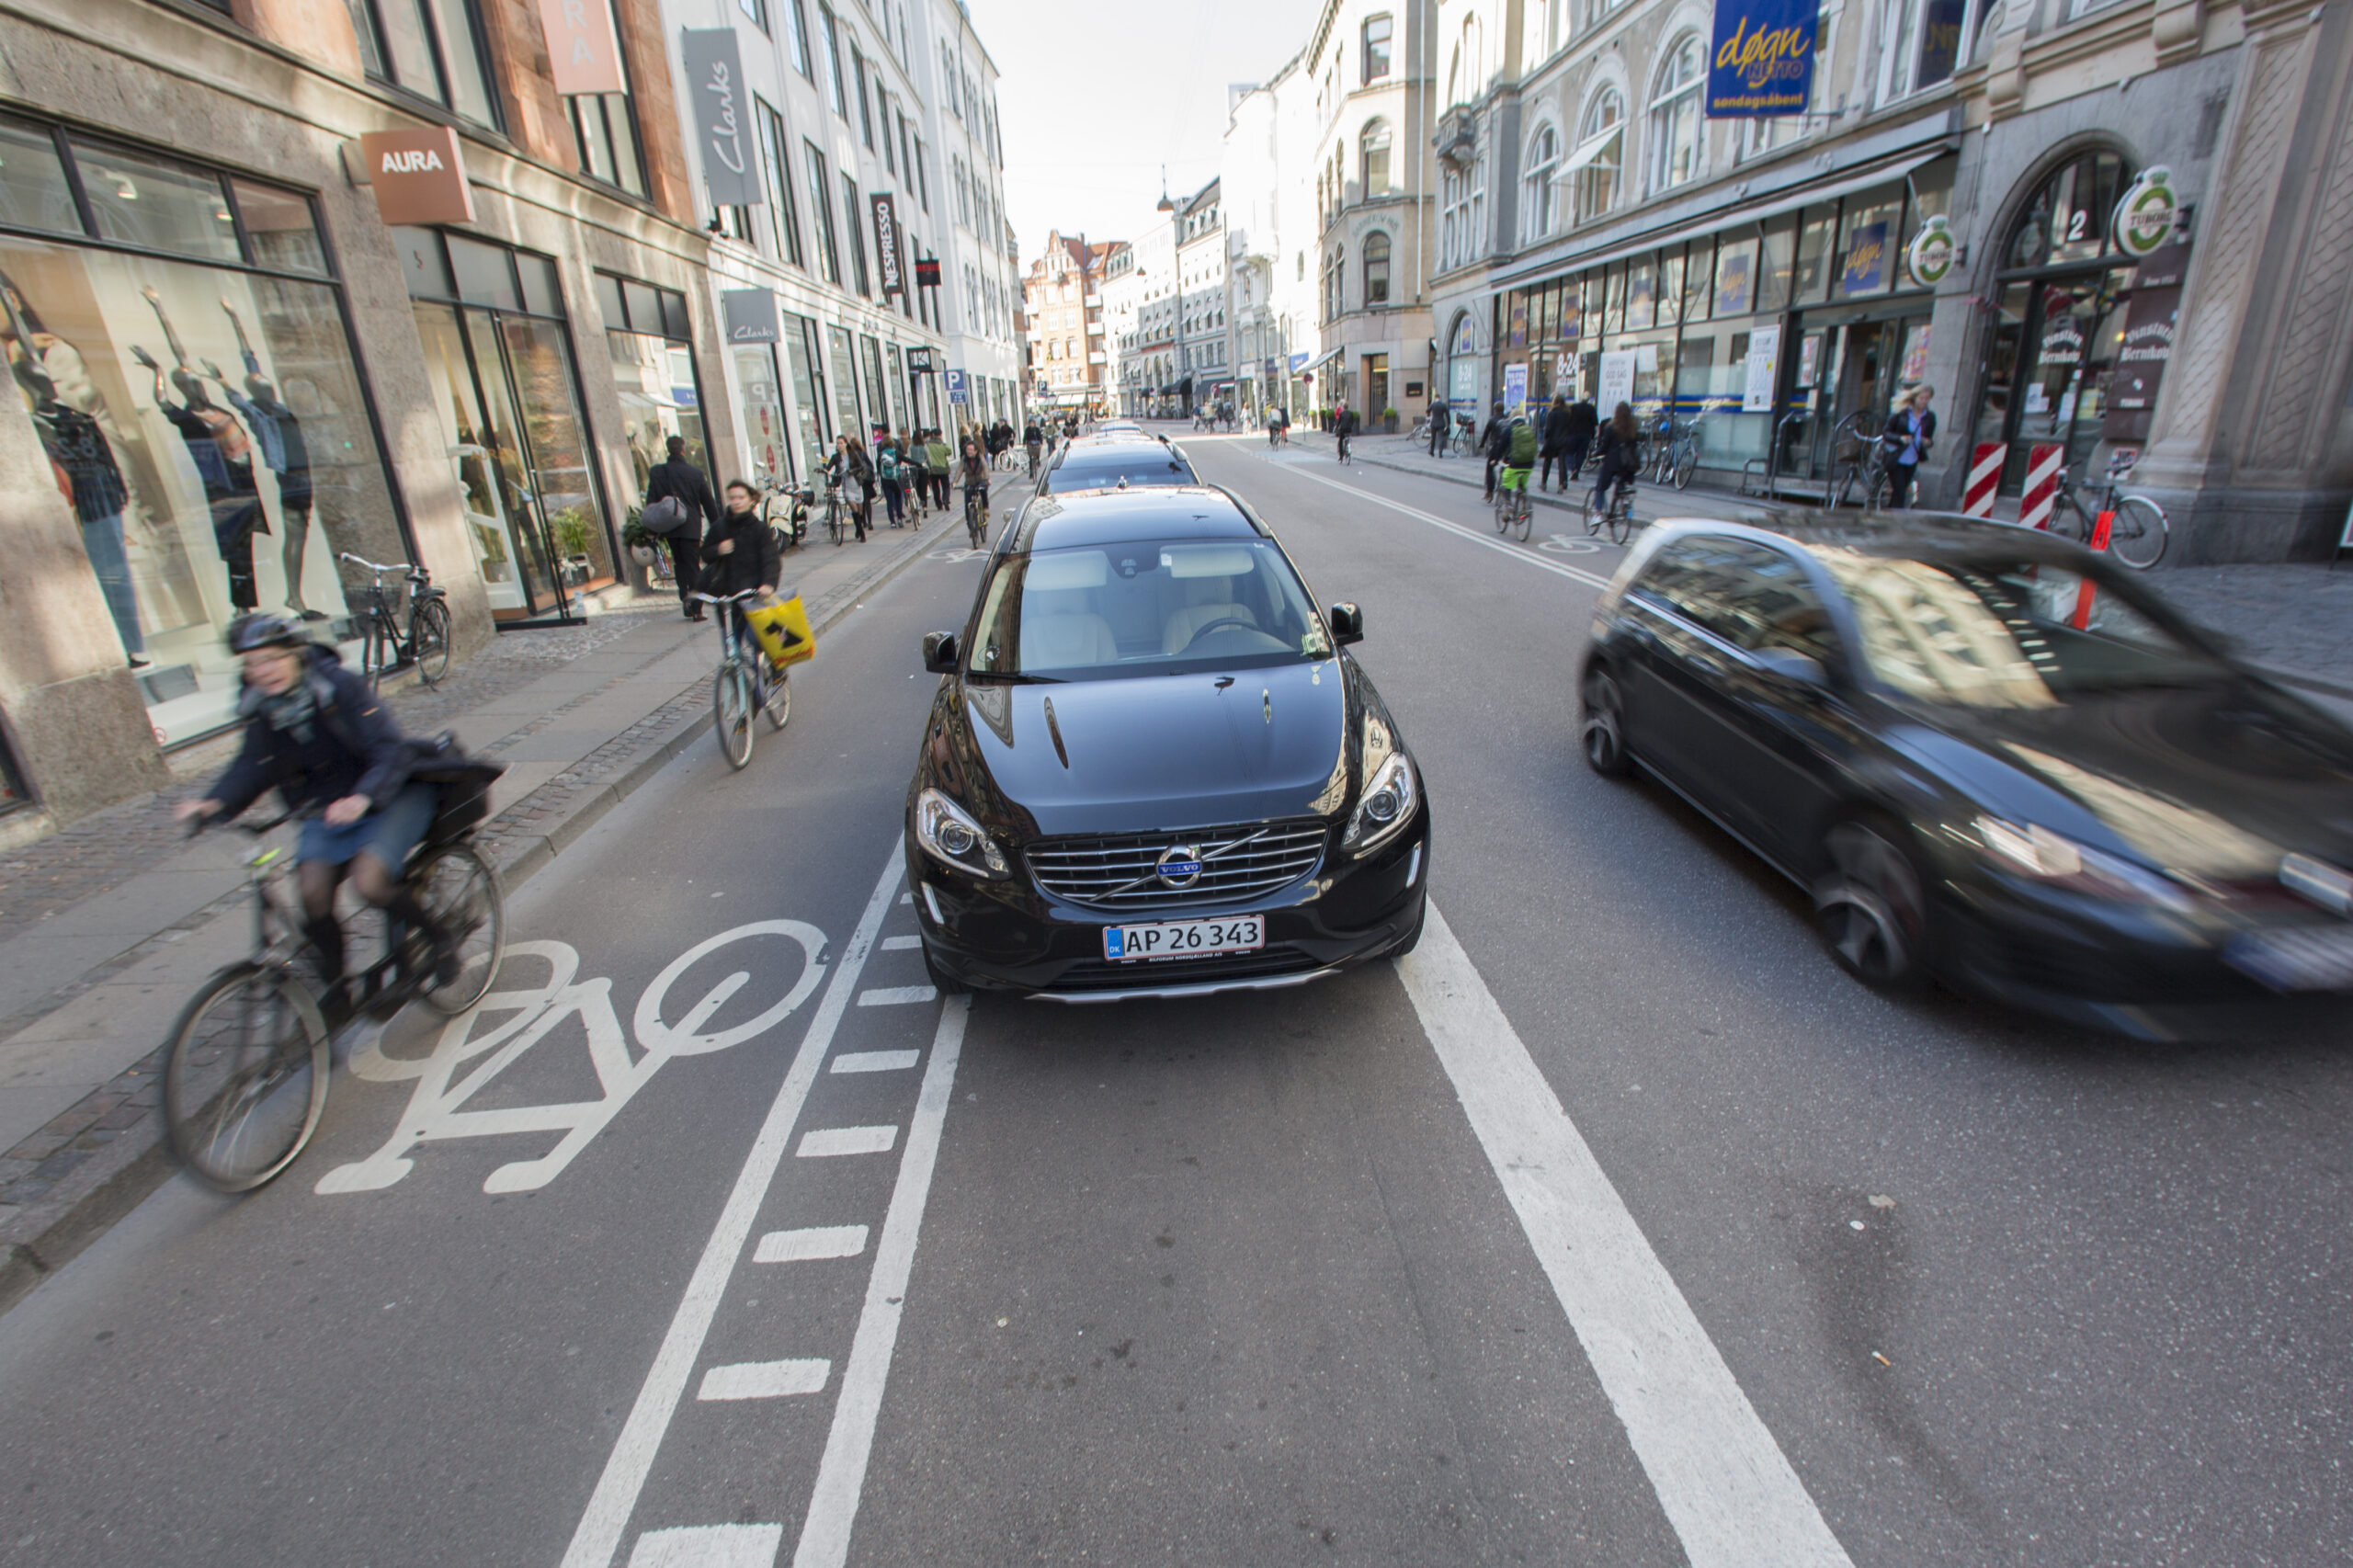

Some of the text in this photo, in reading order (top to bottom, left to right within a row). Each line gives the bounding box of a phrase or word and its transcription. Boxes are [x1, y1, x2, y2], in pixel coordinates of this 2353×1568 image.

[1716, 14, 1811, 89] døgn
[706, 60, 745, 175] Clarks
[381, 149, 444, 173] AURA
[2067, 209, 2087, 242] 2
[2129, 210, 2173, 226] TUBORG
[876, 201, 899, 290] NESPRESSO
[734, 325, 775, 341] Clarks
[1558, 352, 1578, 376] 8-24
[948, 371, 961, 390] P
[1039, 381, 1045, 391] P
[1160, 864, 1199, 873] VOLVO
[1126, 922, 1258, 953] AP 26 343
